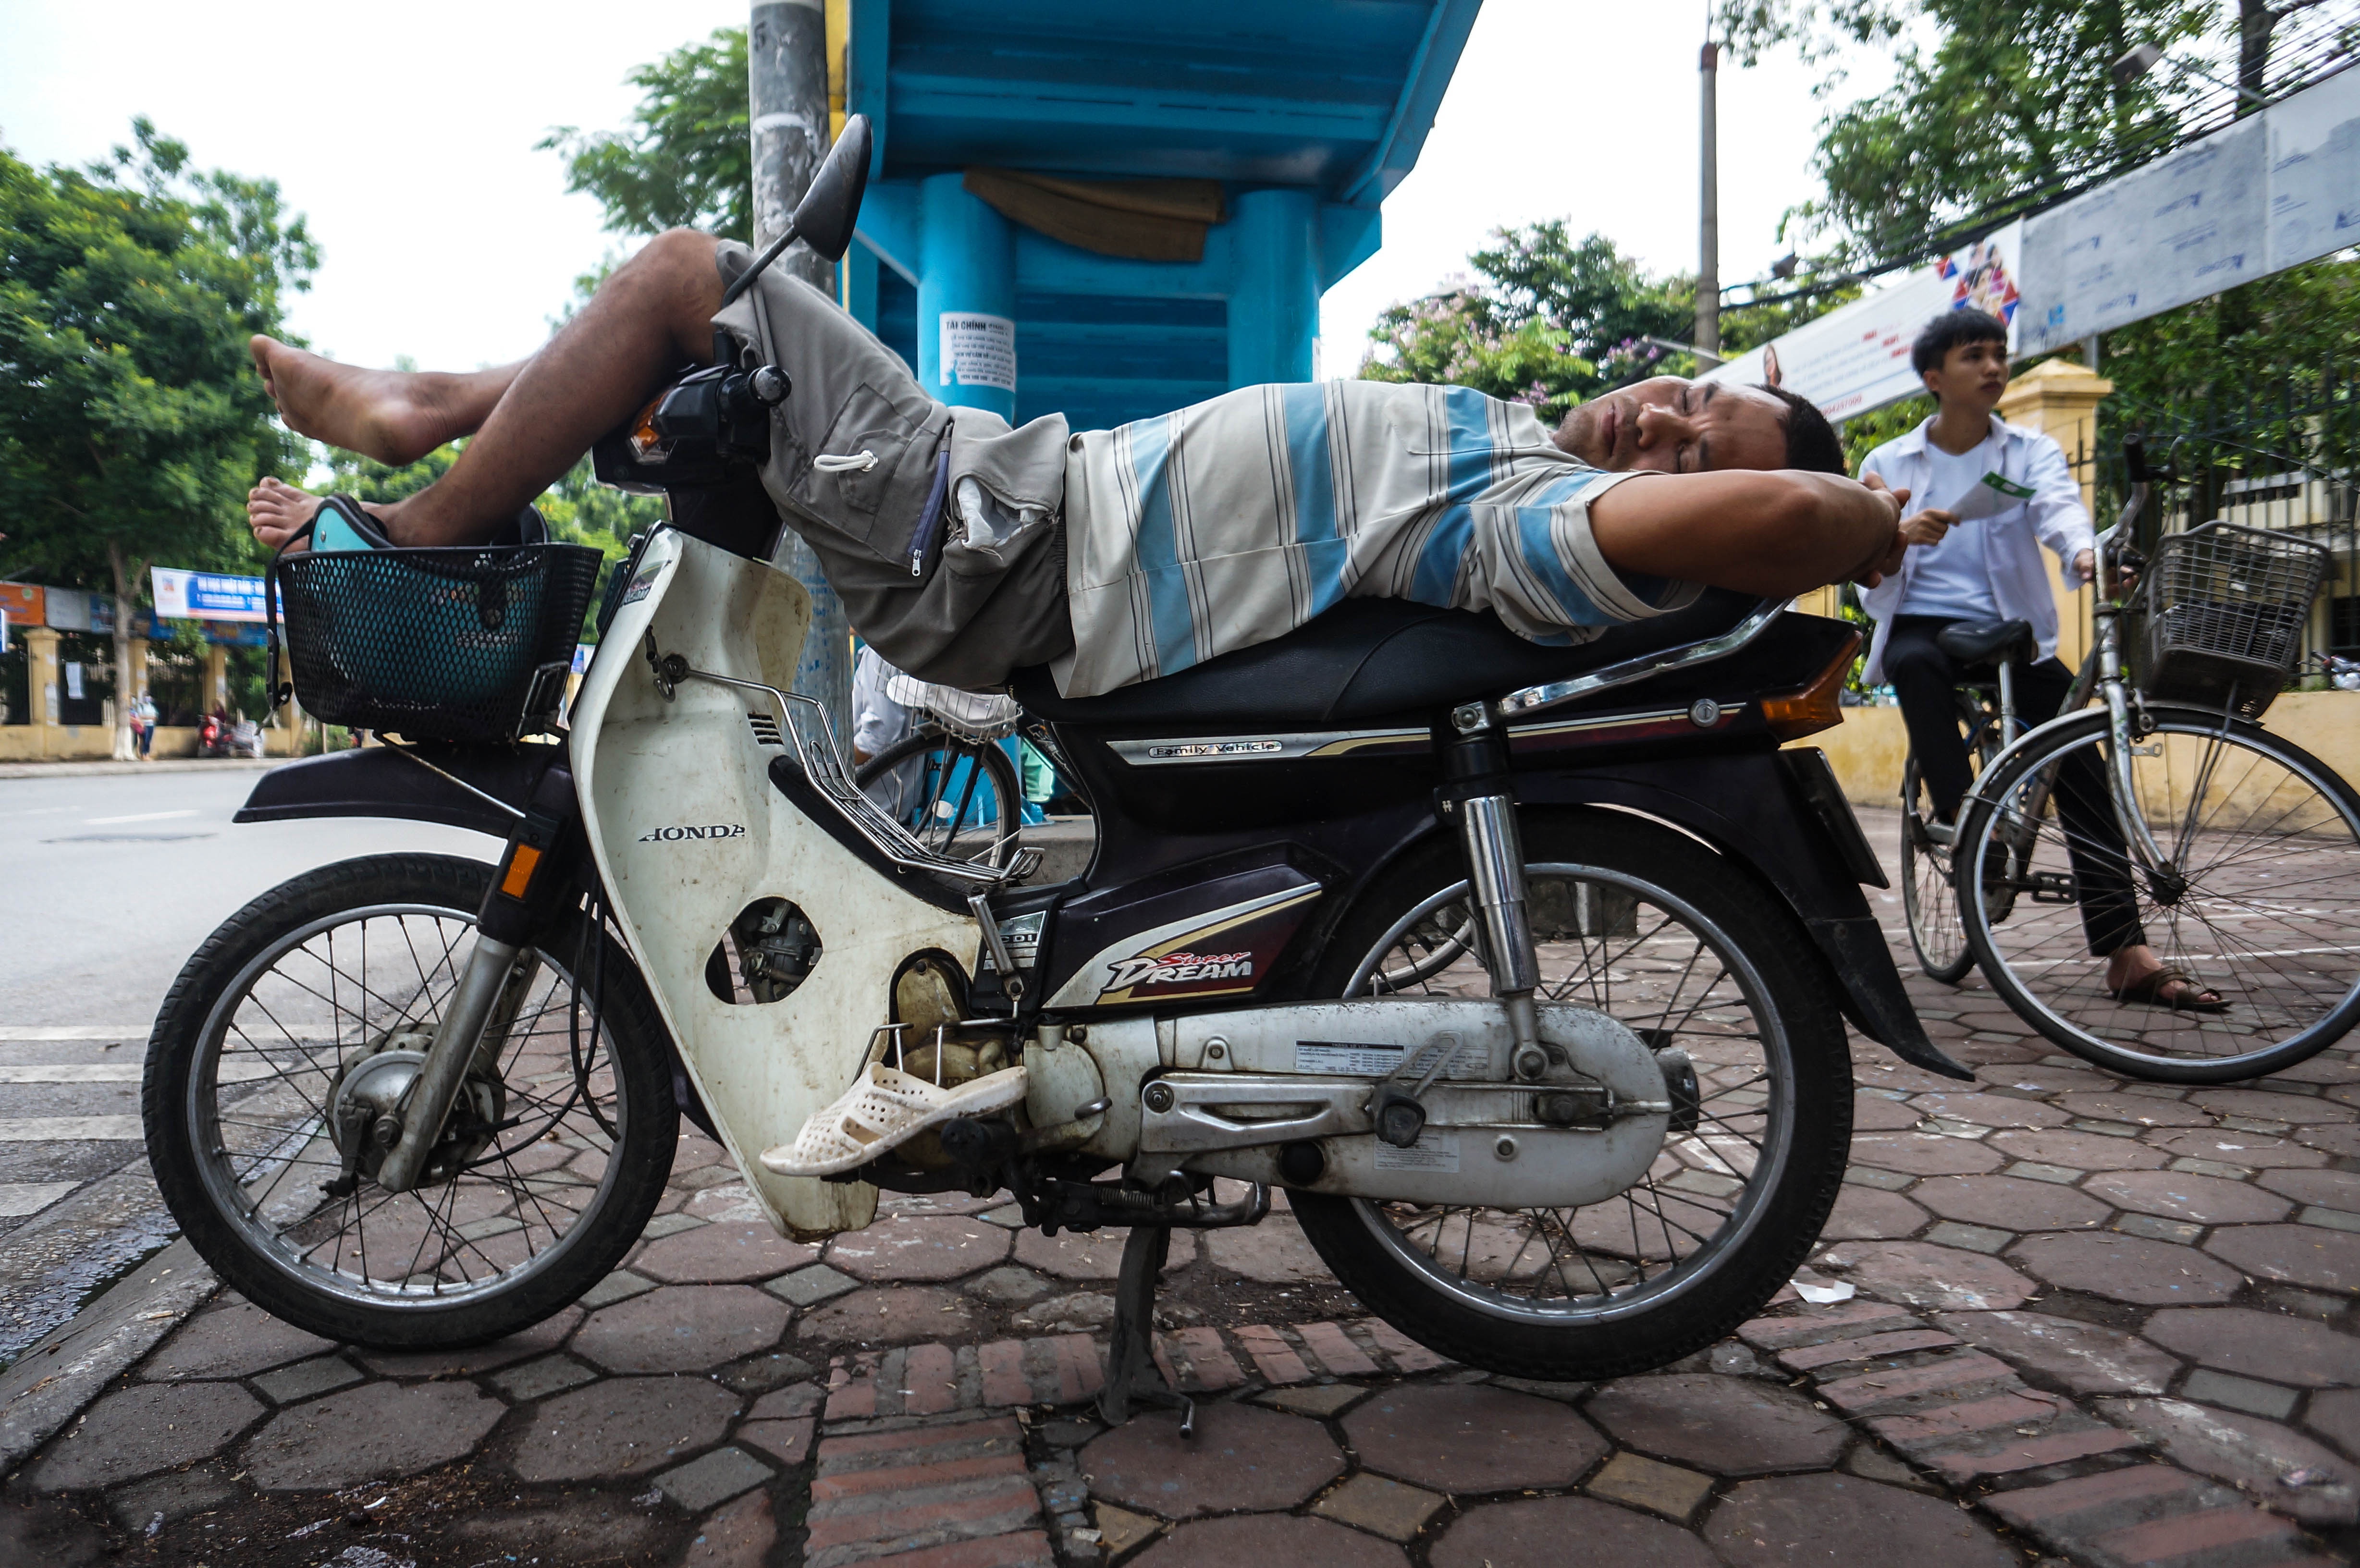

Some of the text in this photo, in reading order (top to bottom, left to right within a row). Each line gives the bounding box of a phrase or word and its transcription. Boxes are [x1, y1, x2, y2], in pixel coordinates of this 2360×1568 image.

[946, 319, 958, 330] TÀI
[961, 320, 986, 331] CHÍNH
[1156, 743, 1275, 756] Family Vehicle
[639, 824, 746, 842] HONDA
[1001, 934, 1032, 943] CDI
[1149, 952, 1252, 970] Super
[1102, 957, 1252, 992] DREAM
